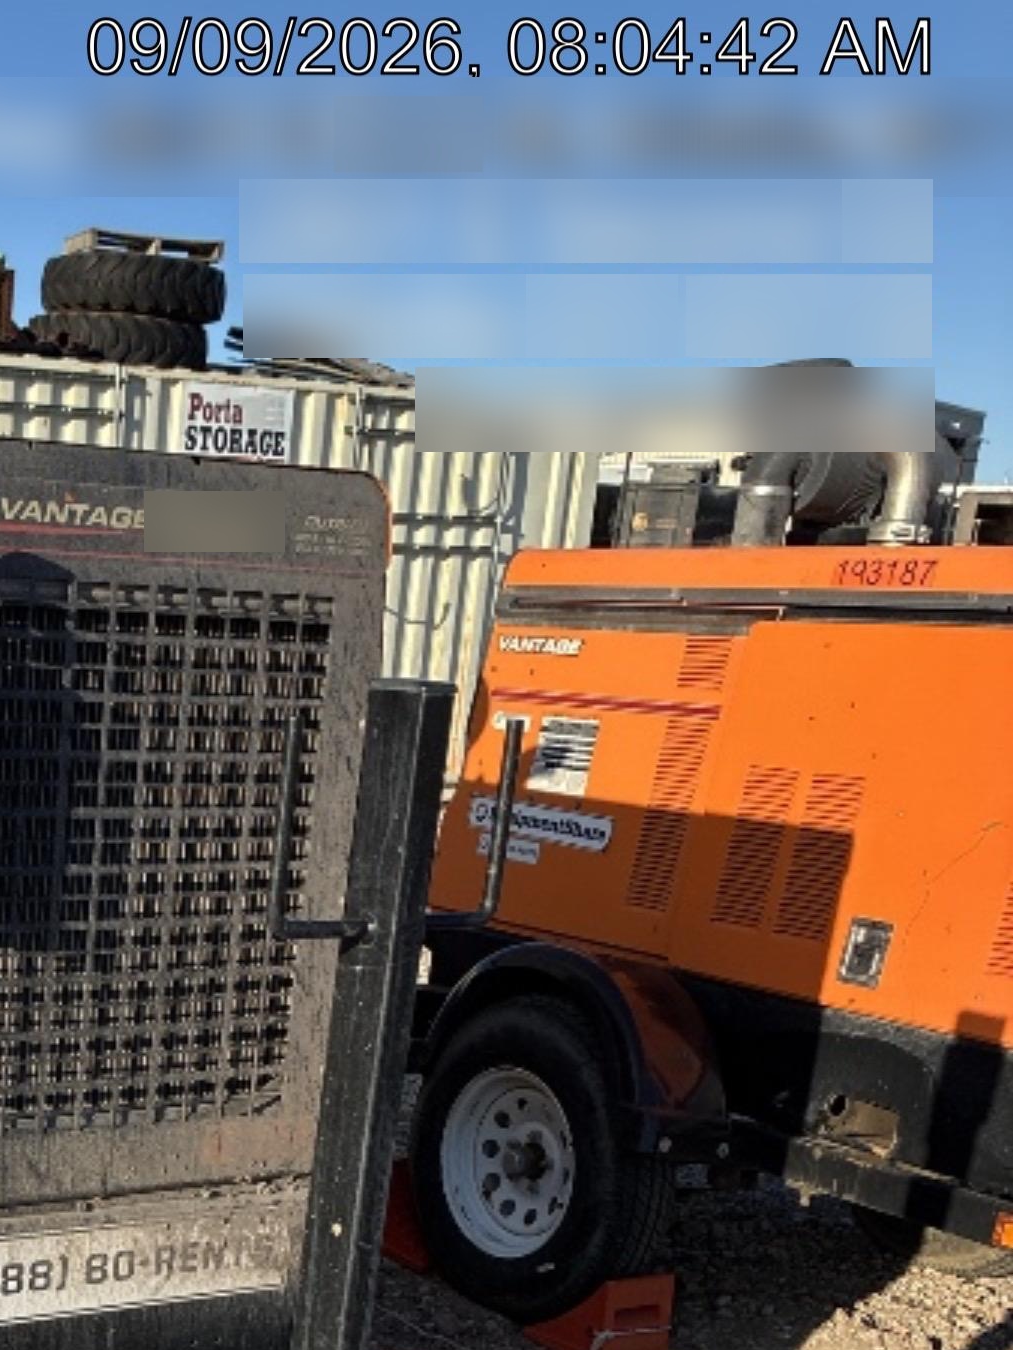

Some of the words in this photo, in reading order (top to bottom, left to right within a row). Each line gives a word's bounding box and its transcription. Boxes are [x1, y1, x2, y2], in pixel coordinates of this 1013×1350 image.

[188, 393, 243, 424] Porta
[185, 426, 285, 456] STORAGE
[837, 558, 939, 587] 193187
[499, 635, 583, 656] VANTAGE
